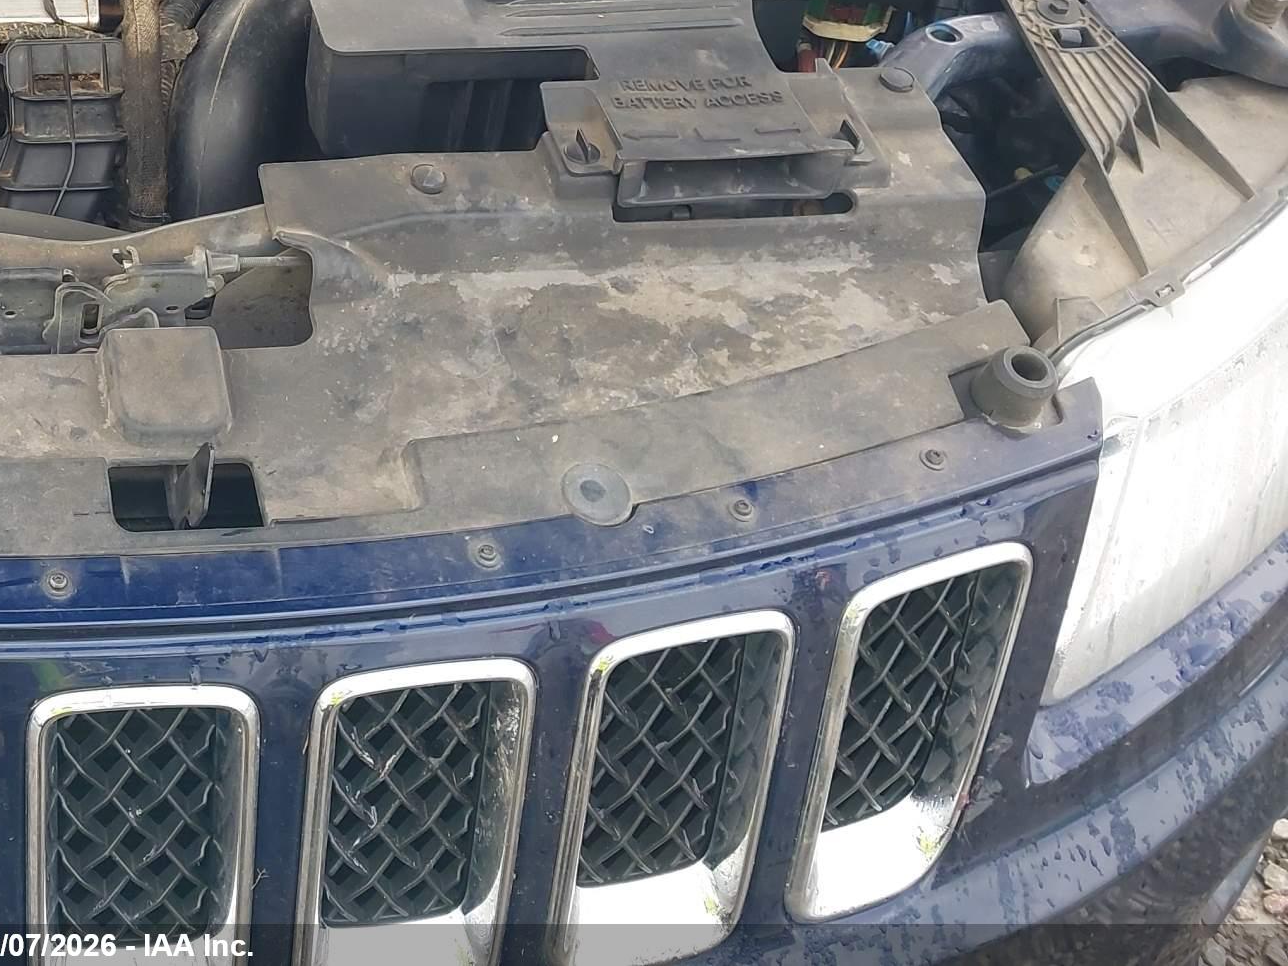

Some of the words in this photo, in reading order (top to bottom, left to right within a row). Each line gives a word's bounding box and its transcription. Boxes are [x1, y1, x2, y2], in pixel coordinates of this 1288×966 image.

[619, 78, 705, 92] REMOVE
[710, 76, 752, 90] FOR
[612, 95, 697, 110] BATTERY
[704, 91, 784, 108] ACCESS
